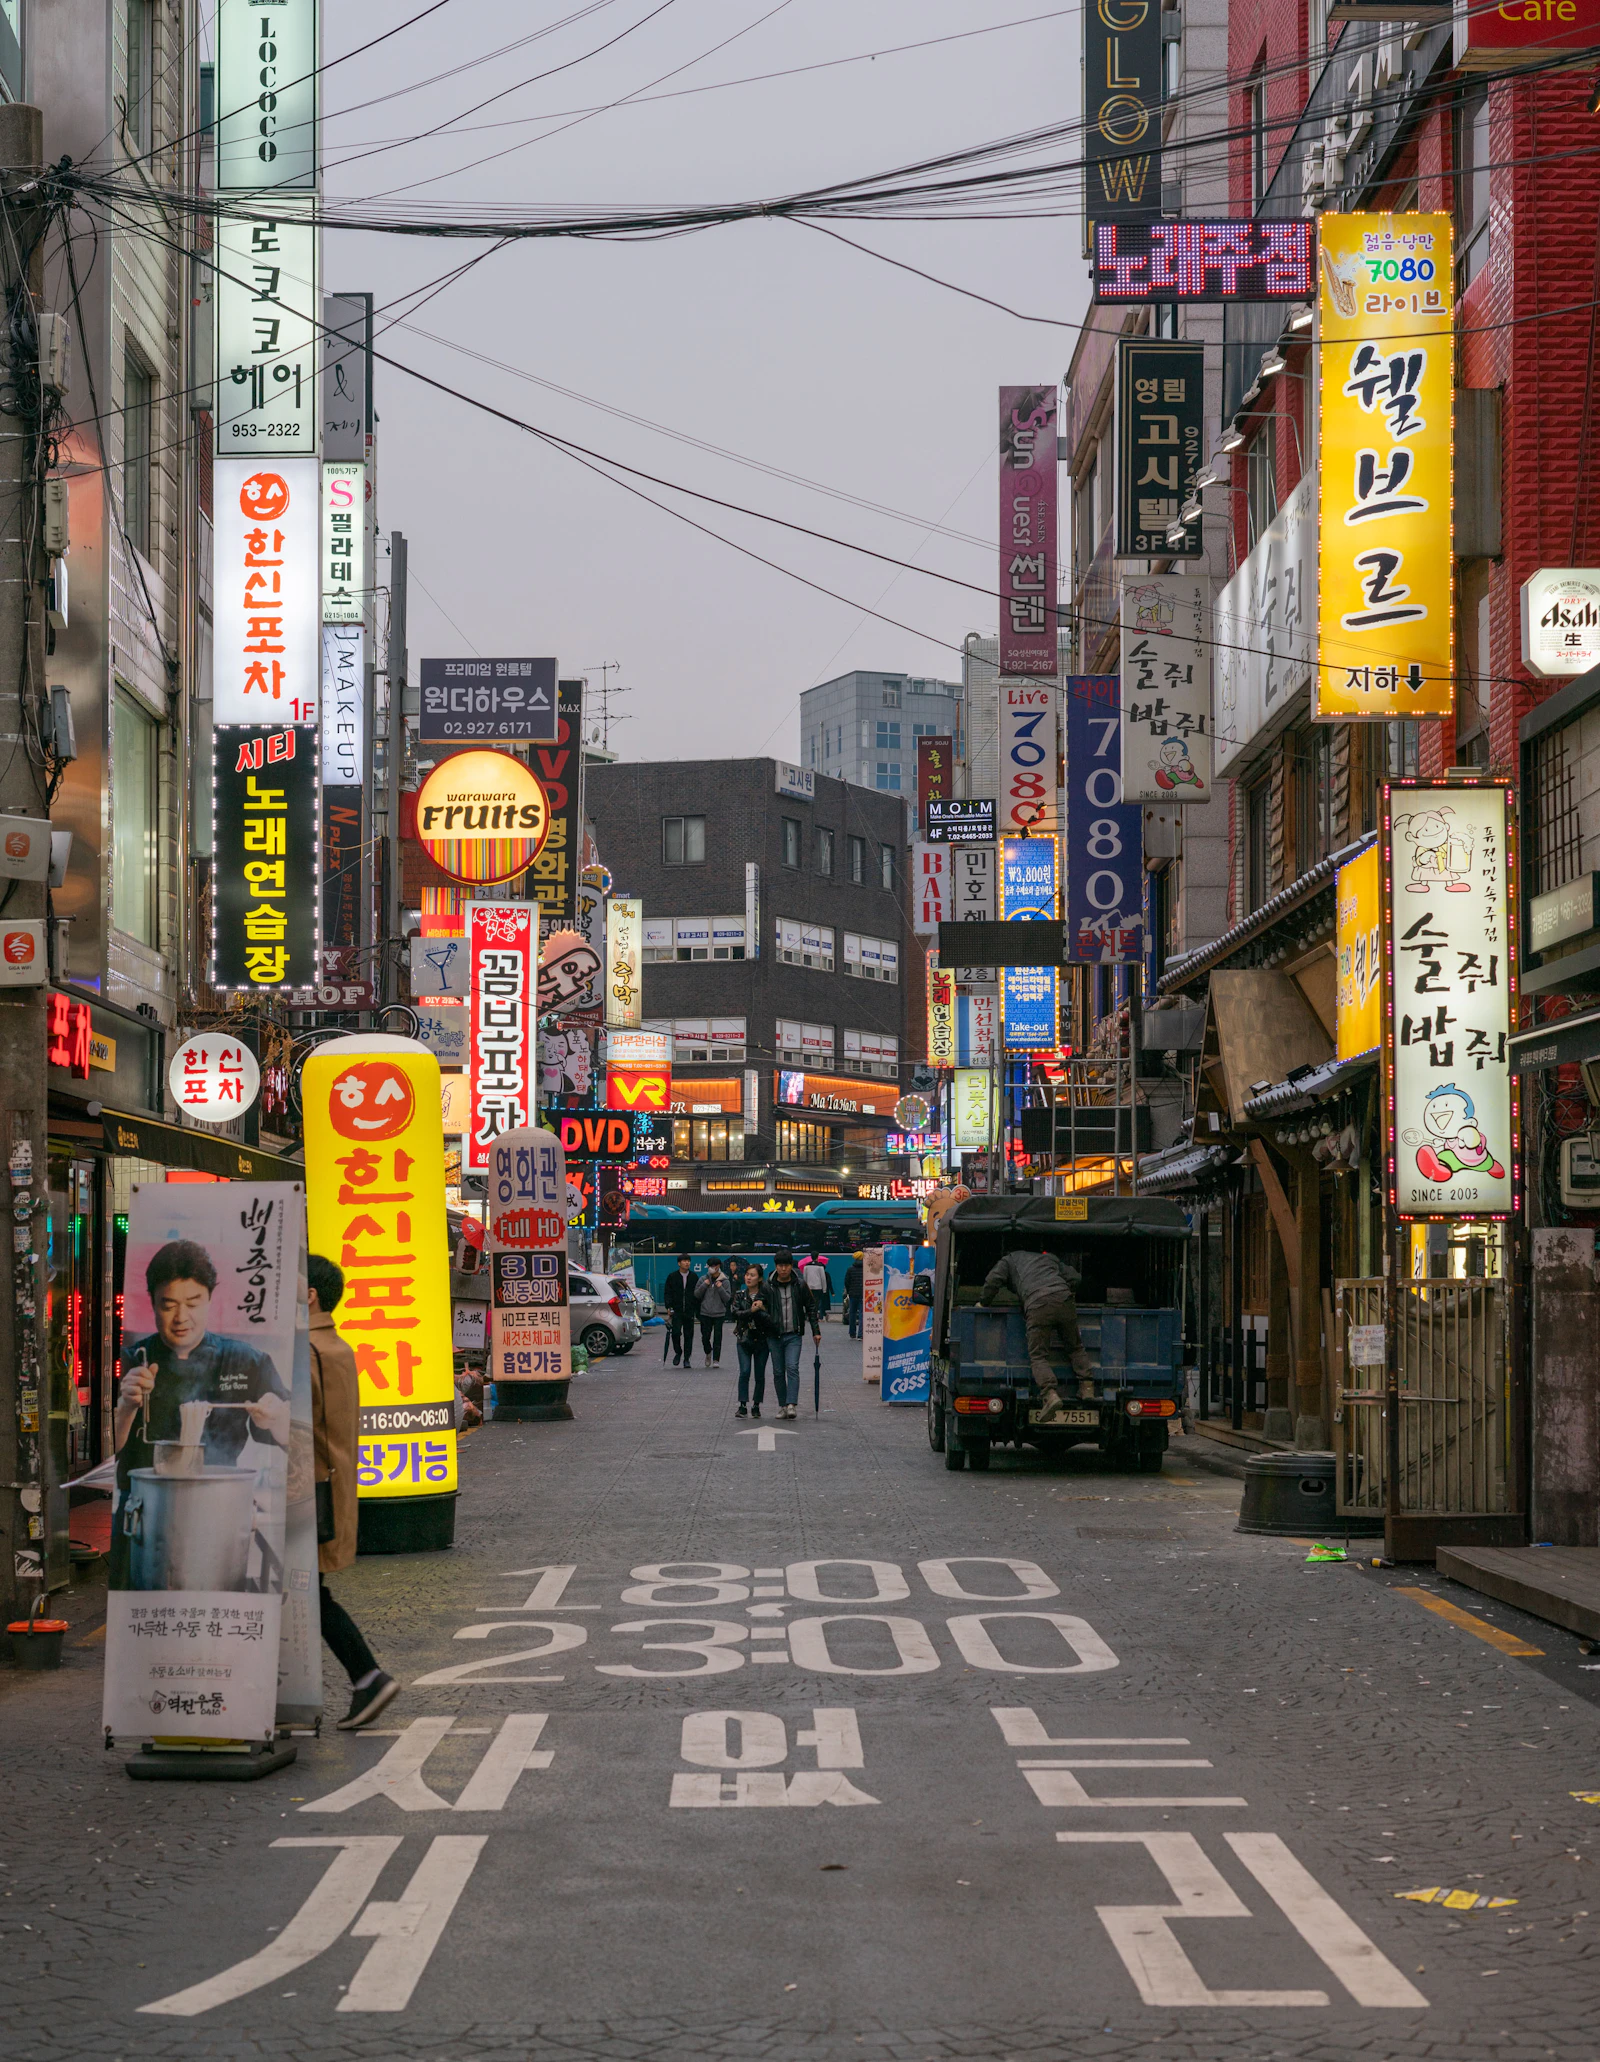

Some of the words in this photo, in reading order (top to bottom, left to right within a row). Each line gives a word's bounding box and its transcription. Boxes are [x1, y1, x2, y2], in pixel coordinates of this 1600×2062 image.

[259, 17, 278, 163] LOCOCO
[1098, 0, 1150, 202] GLOW
[1100, 224, 1310, 296] 노래주점
[1365, 258, 1434, 283] 7080
[251, 223, 281, 355] 로코코
[1365, 291, 1446, 314] 라이브
[230, 363, 302, 410] 헤어
[1135, 378, 1186, 404] 영림
[232, 424, 301, 438] 953-2322
[1137, 414, 1180, 531] 고시텔
[1345, 344, 1425, 627] 쉘브르
[331, 513, 353, 605] 필라테스
[243, 527, 287, 700] 한신포차
[324, 611, 359, 619] 6215-1004
[1564, 632, 1582, 647] 生
[445, 663, 492, 677] 프리미엄
[496, 662, 532, 677] 원룸텔
[1003, 660, 1053, 670] T.921-2167
[1128, 640, 1193, 690] 술줘
[1346, 666, 1399, 693] 지하
[289, 697, 315, 720] 1F
[424, 686, 551, 714] 원더하우스
[1008, 690, 1048, 706] Live
[443, 721, 532, 736] 02.927.6171
[1130, 697, 1205, 738] 밥줘
[235, 729, 296, 773] 시티
[1010, 712, 1047, 826] 7080
[447, 793, 516, 803] warawara
[1139, 790, 1158, 798] SINCE
[1161, 790, 1178, 798] 2003
[423, 804, 541, 831] Fruits
[1085, 717, 1124, 911] 7080
[930, 828, 942, 839] 4F
[244, 775, 291, 984] 노래연습장
[922, 852, 942, 923] BAR
[1076, 928, 1137, 957] 콘서트
[1400, 912, 1500, 995] 술줘
[613, 961, 638, 1005] 주막
[963, 967, 989, 980] 2층
[425, 996, 440, 1004] DIY
[932, 970, 953, 1057] 노래연습장
[1010, 1022, 1048, 1032] Take-out
[1400, 1005, 1507, 1071] 밥줘
[612, 1035, 667, 1047] 피부관리샵
[183, 1048, 243, 1075] 한신
[182, 1077, 245, 1104] 포차
[612, 1077, 666, 1106] VR
[560, 1117, 630, 1154] DVD
[496, 1146, 557, 1202] 영화관
[1411, 1189, 1443, 1203] SINCE
[1449, 1187, 1479, 1201] 2003
[501, 1218, 530, 1238] Full
[537, 1217, 560, 1238] HD
[236, 1197, 275, 1324] 백종원
[334, 1148, 422, 1397] 한신포차
[502, 1280, 559, 1304] 진동의자
[501, 1311, 561, 1327] HD프로젝터
[502, 1330, 561, 1347] 새것전체교체
[503, 1351, 562, 1374] 흡연가능
[1063, 1411, 1092, 1423] 7551
[128, 1620, 168, 1638] 가득한
[171, 1621, 201, 1638] 우동
[206, 1621, 223, 1637] 한
[167, 1692, 224, 1715] 역전우동
[200, 1708, 221, 1716] 0410
